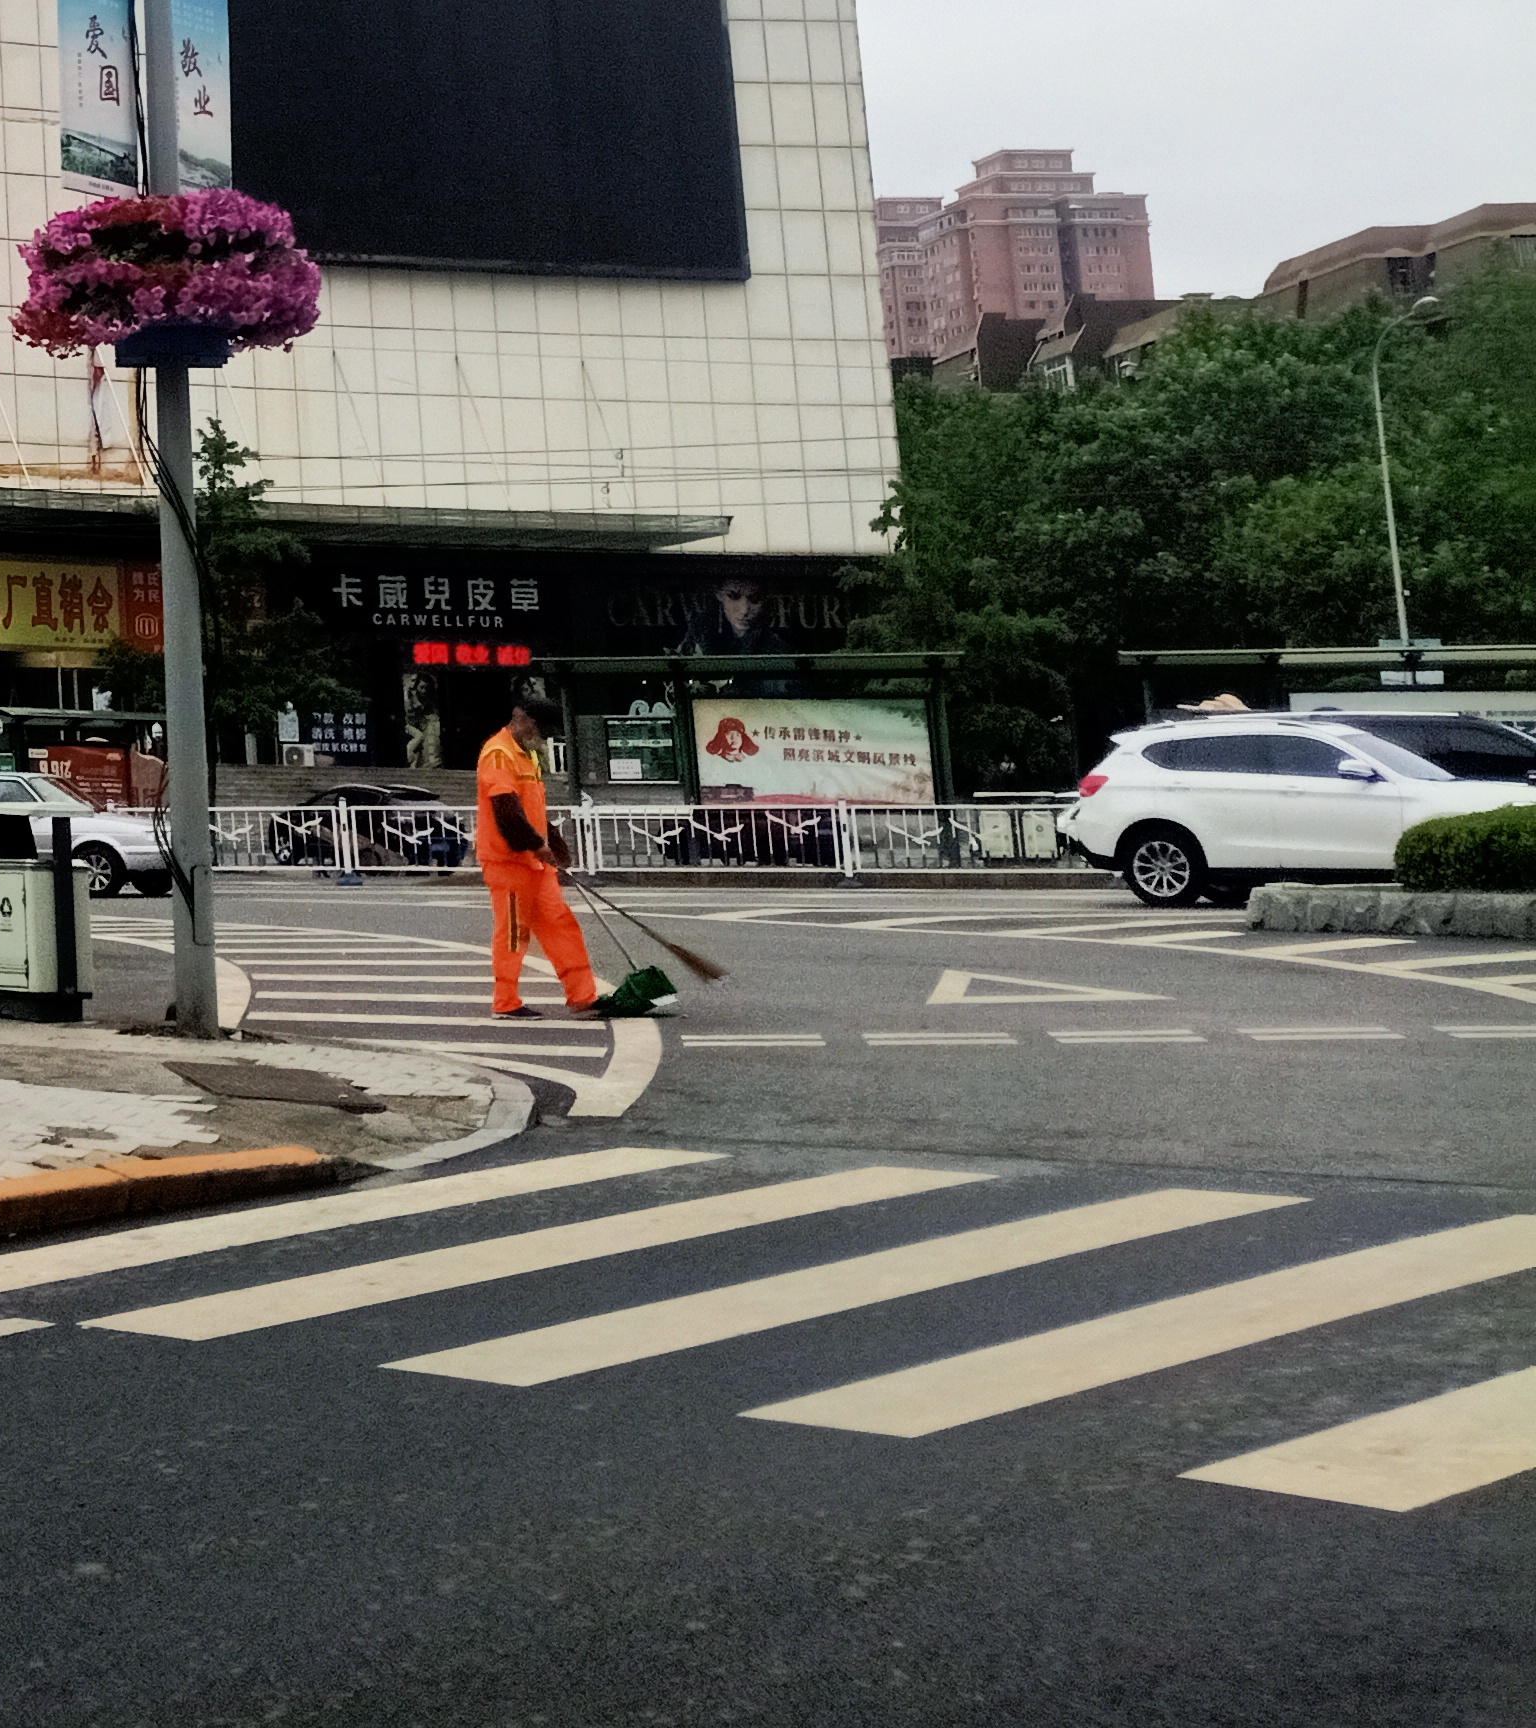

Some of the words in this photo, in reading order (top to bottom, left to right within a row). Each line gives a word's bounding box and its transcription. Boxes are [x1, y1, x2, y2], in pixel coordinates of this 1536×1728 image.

[764, 726, 851, 743] 传承雷锋精神
